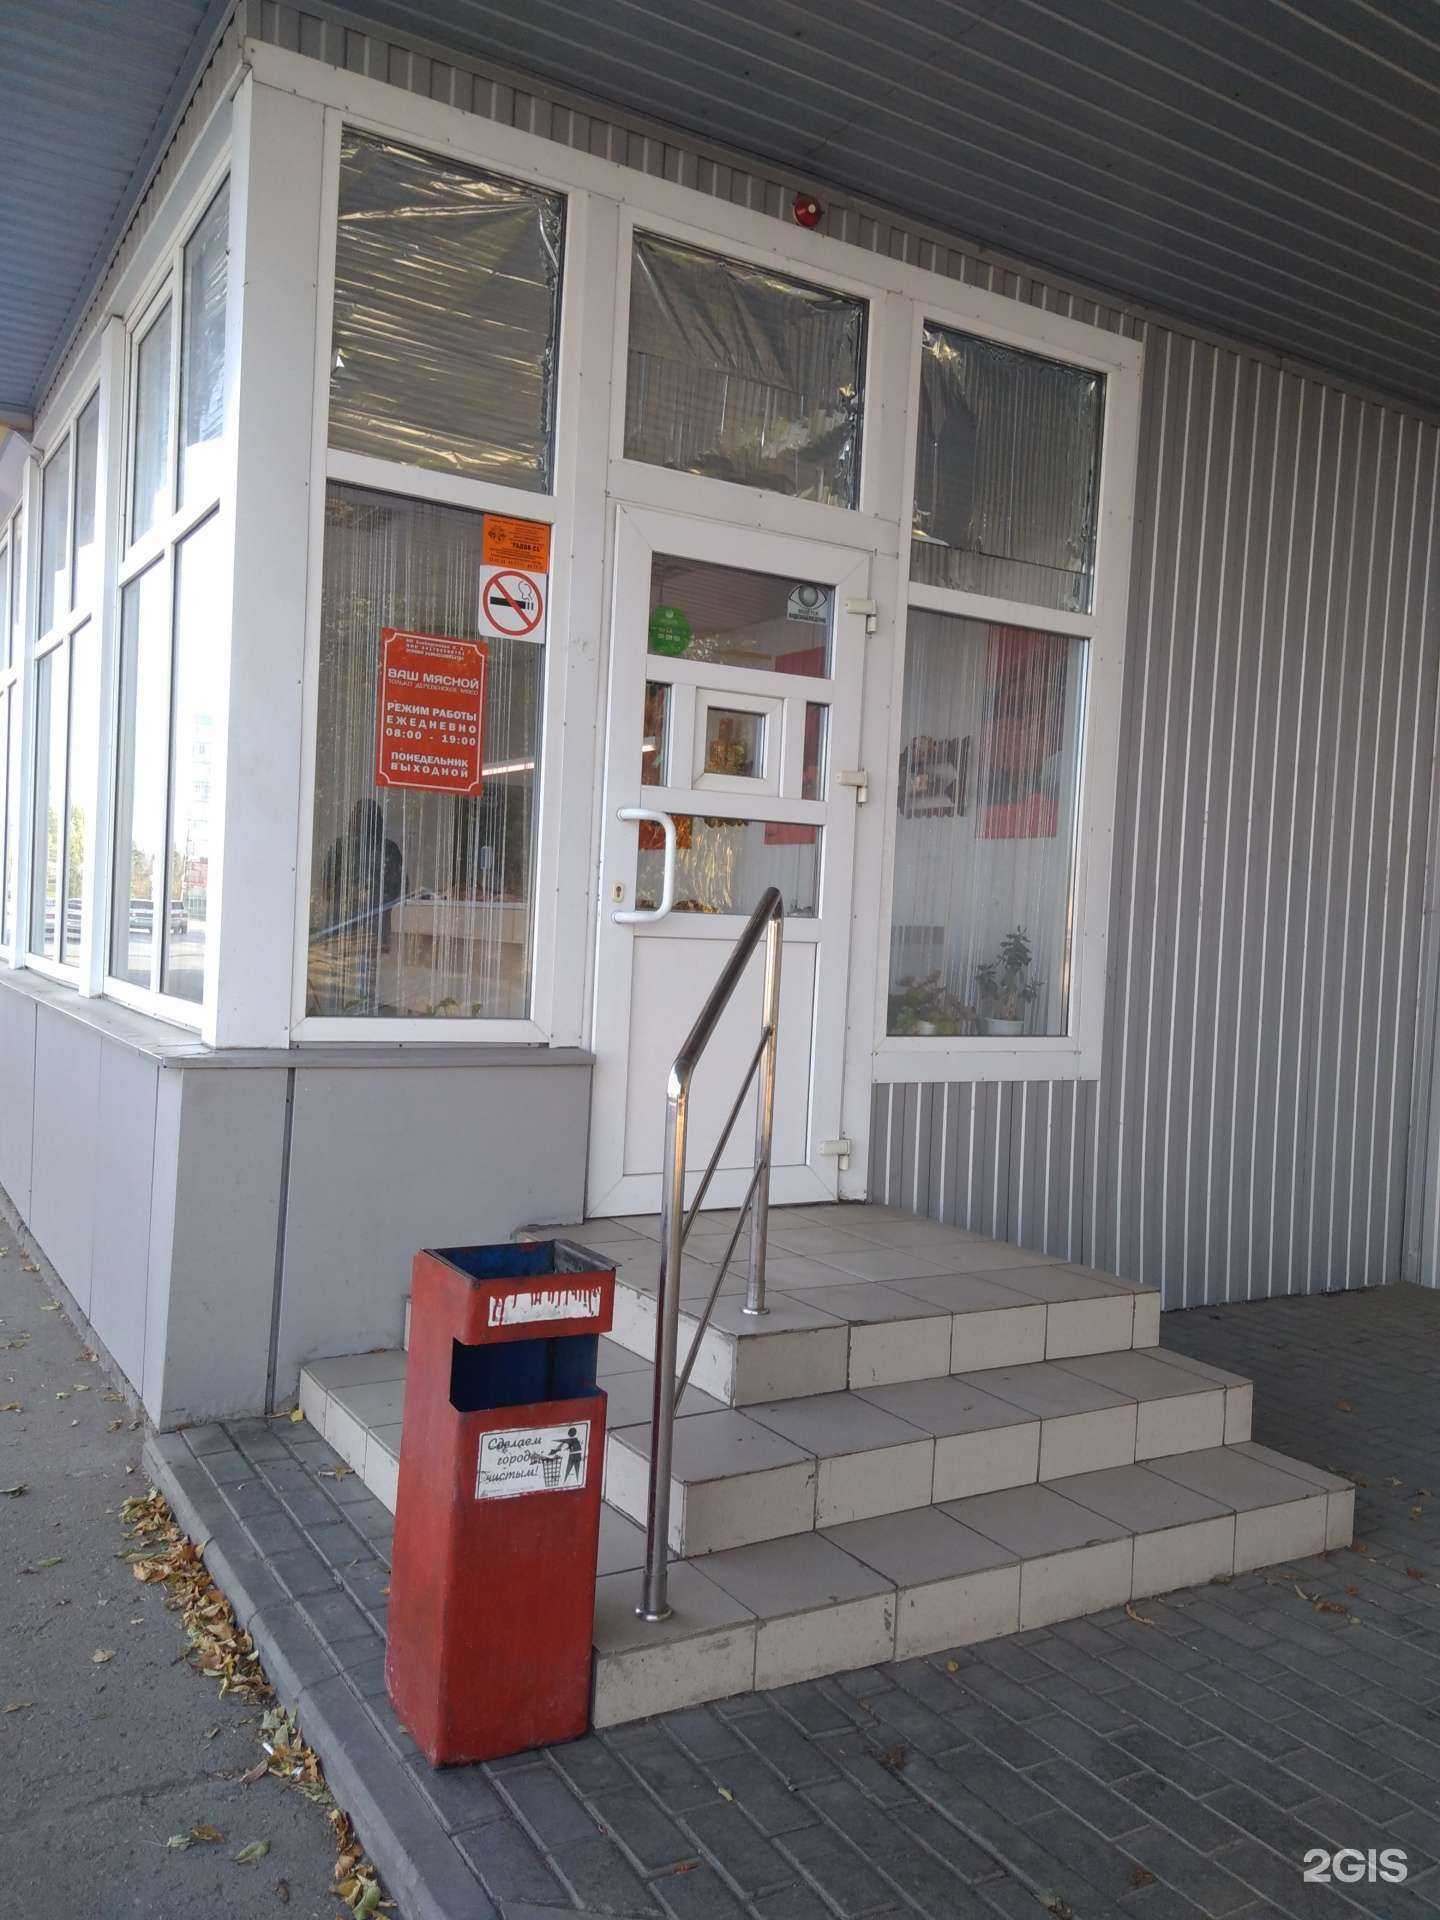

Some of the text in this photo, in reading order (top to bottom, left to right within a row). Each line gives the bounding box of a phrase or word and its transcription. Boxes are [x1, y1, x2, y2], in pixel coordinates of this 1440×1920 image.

[388, 667, 480, 690] ВАШ МЯСНОЙ
[387, 702, 477, 721] РЕЖИМ РАБОТЫ
[386, 715, 477, 734] ЕЖЕДНЕВНО
[386, 727, 422, 740] 08:00
[441, 734, 476, 746] 19:00
[391, 751, 469, 768] ПОНЕДЕЛЬНИК
[390, 762, 469, 778] ВЫХОДНОЙ
[487, 1437, 542, 1454] Сделаем
